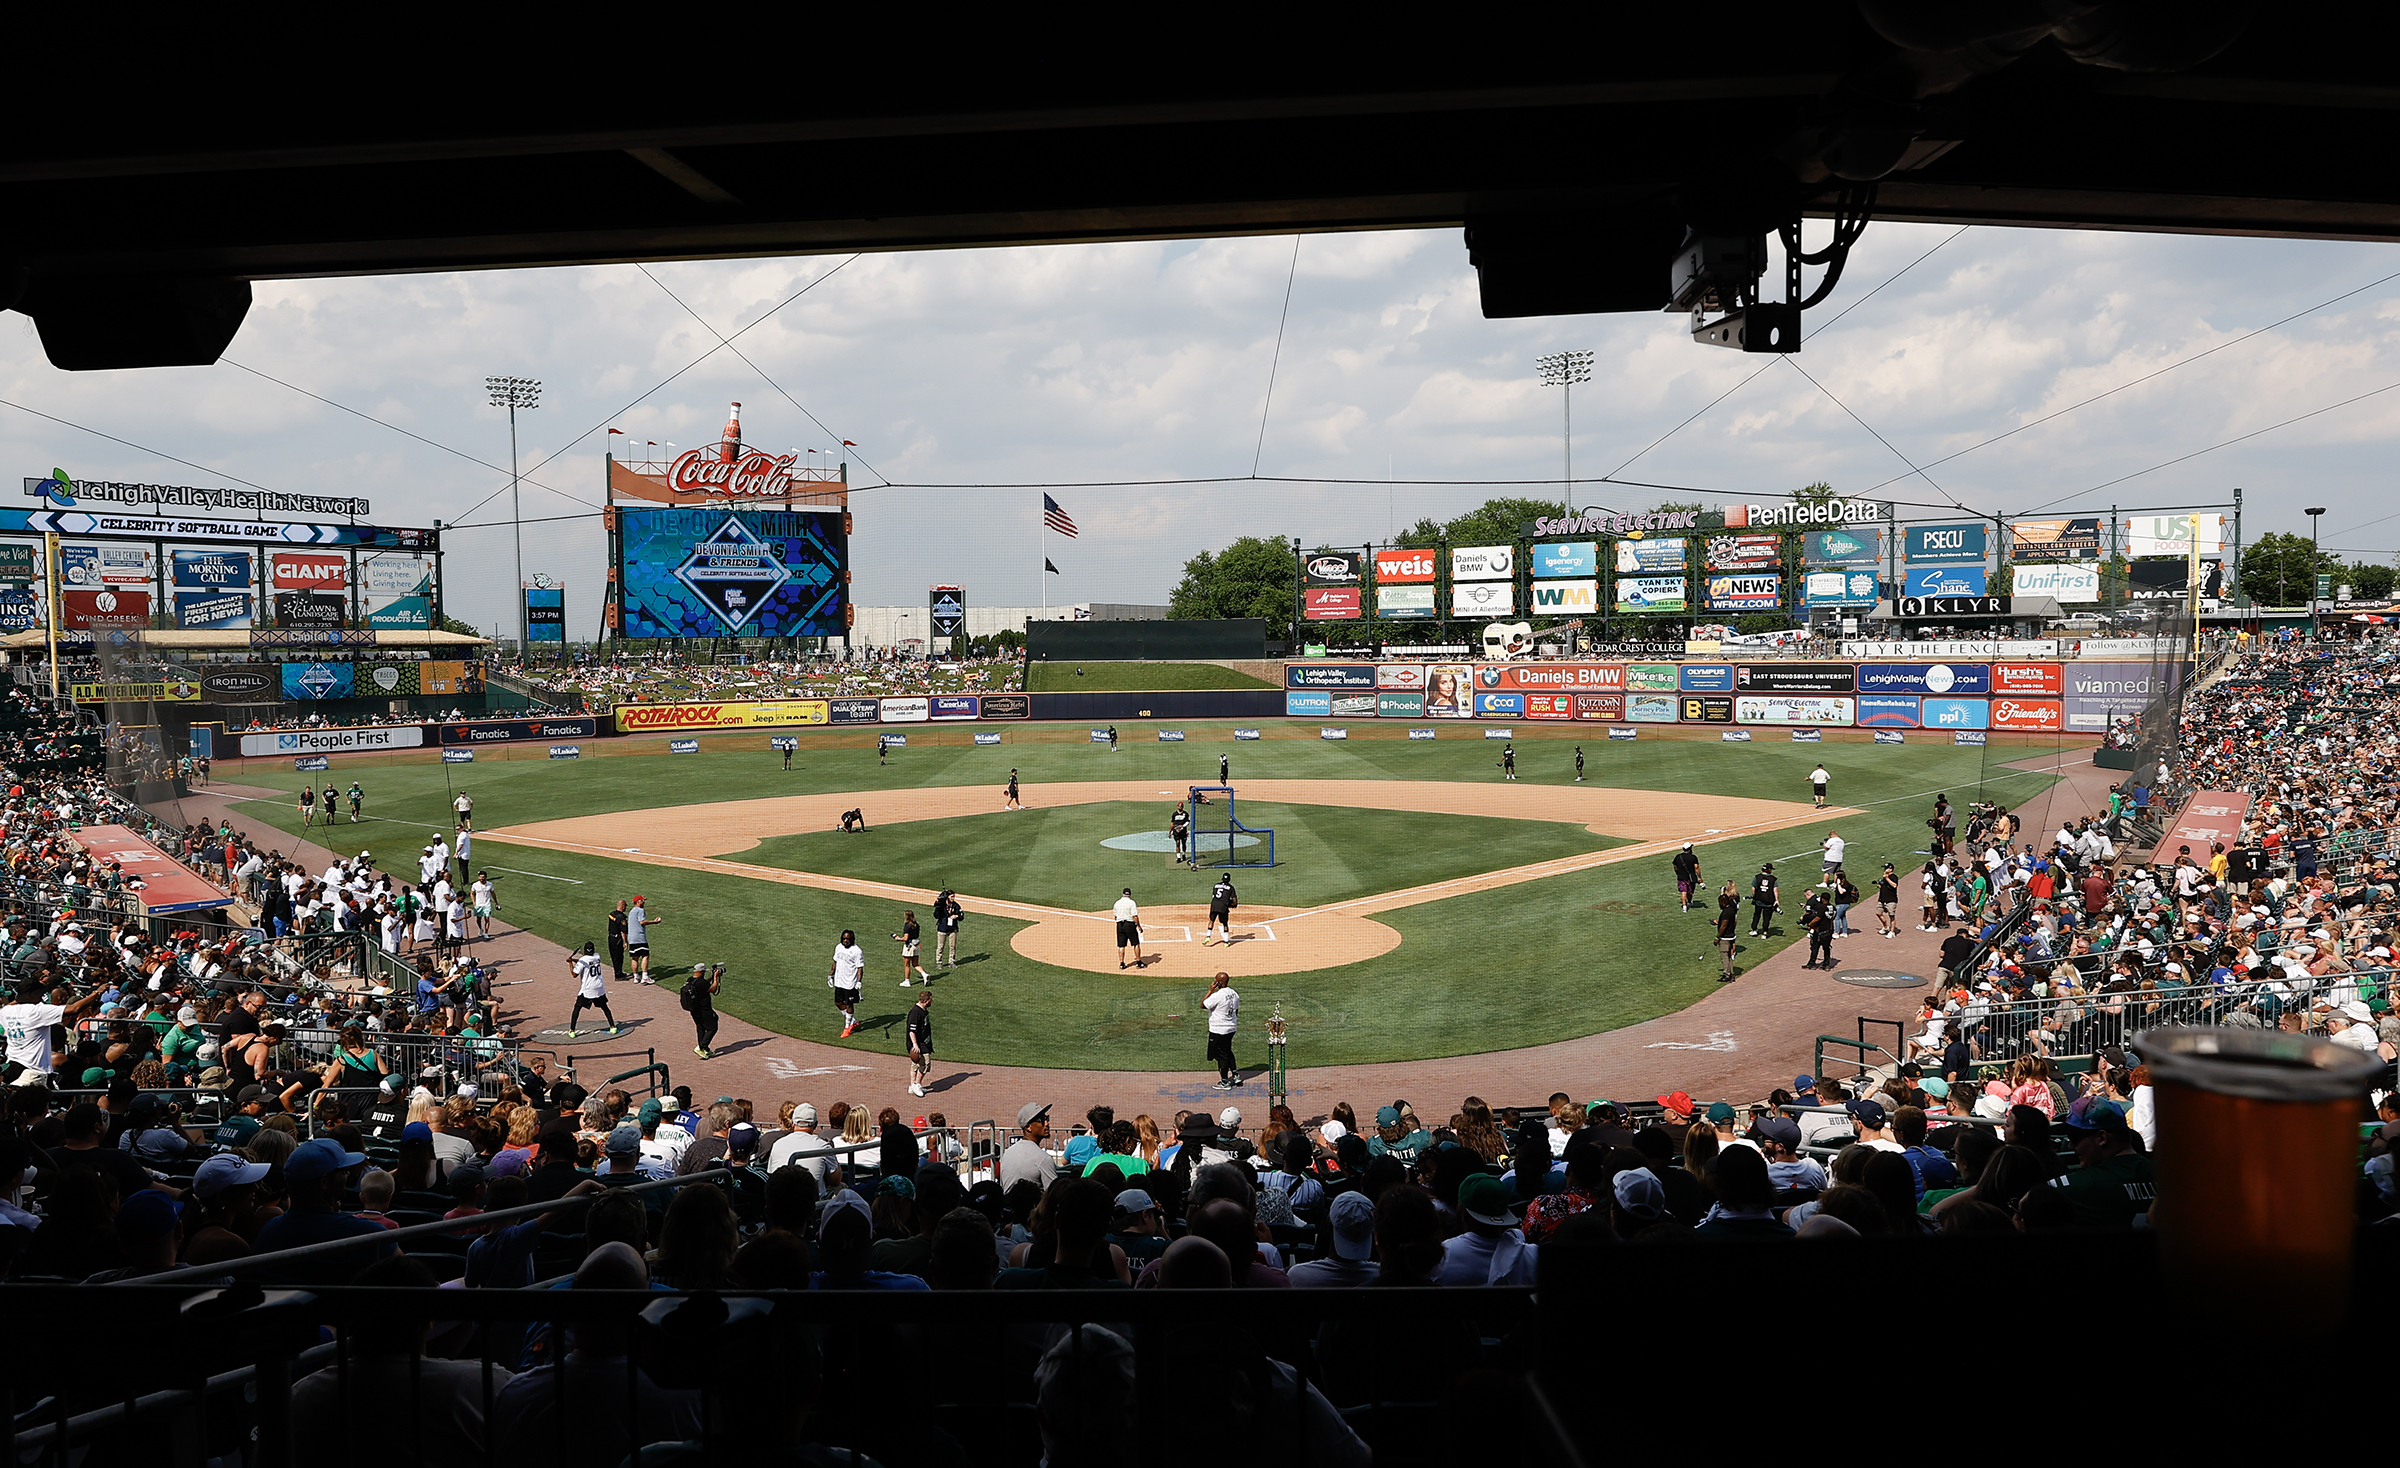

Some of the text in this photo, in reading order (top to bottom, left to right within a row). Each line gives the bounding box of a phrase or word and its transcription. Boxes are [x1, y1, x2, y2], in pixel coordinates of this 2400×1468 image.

[669, 452, 798, 496] Coca-Cola
[78, 480, 367, 515] Lehigh Valley Health Network
[1748, 500, 1878, 525] PenTeleData
[100, 518, 279, 537] CELEBRITY SOFTBALL GAME
[1533, 511, 1698, 537] SERVICE ELECTRIC
[2154, 516, 2190, 541] US
[1924, 531, 1964, 550] PSECU
[2154, 541, 2190, 551] FOODS
[12, 548, 29, 561] Visit
[696, 544, 770, 556] DEVONTA SMITH
[201, 556, 224, 565] THE
[710, 558, 759, 567] & FRIENDS
[1456, 554, 1488, 563] Daniels
[188, 564, 239, 575] MORNING
[372, 561, 419, 570] Working here.
[1378, 555, 1434, 576] weis
[1460, 564, 1484, 573] BMW
[275, 563, 341, 580] GIANT
[373, 570, 412, 579] Living here.
[200, 574, 228, 583] CALL
[1921, 570, 1971, 598] Shane
[2017, 573, 2094, 589] UniFirst
[373, 580, 414, 589] Giving here.
[1710, 577, 1774, 597] 69 NEWS
[197, 600, 216, 609] LEHIGH
[217, 595, 243, 604] VALLEY'S
[1536, 588, 1591, 606] WM
[184, 601, 243, 617] FIRST SOURCE
[1713, 600, 1774, 609] WFMZ.COM
[1933, 599, 2001, 613] KLYR
[76, 615, 138, 624] WIND CREEK
[184, 608, 244, 625] FOR NEWS
[297, 610, 339, 618] LANDSCAPE
[289, 631, 327, 643] Capital
[1590, 642, 1684, 653] CEDAR CREST COLLEGE
[1847, 643, 2004, 655] KLYR THE FENCE
[2086, 641, 2118, 650] Follow
[1306, 669, 1347, 678] Lehigh Valley
[1519, 669, 1621, 684] Daniels BMW
[1997, 666, 2044, 676] Hursh's
[240, 677, 263, 686] HILL
[1306, 676, 1371, 686] Orthopedic Institute
[1630, 671, 1675, 683] Mike Ike
[431, 684, 446, 692] IPA
[2075, 676, 2168, 694] viamedia
[76, 686, 93, 698] A.D.
[882, 703, 927, 712] AmericanBank
[1389, 700, 1421, 711] Phoebe
[1530, 704, 1551, 712] RUSH
[1578, 697, 1620, 708] KUTZTOWN
[1768, 699, 1821, 707] SERVICE ELECTRIC
[1861, 700, 1917, 708] HomeRunRehab.org
[2100, 703, 2142, 711] On Screen
[833, 704, 876, 713] DUAL TEMP
[1138, 709, 1151, 717] 400
[1632, 705, 1655, 714] Dorney
[1996, 701, 2059, 722] Friendly's
[752, 714, 774, 724] Jeep
[849, 710, 873, 719] team
[1939, 711, 1960, 725] ppl
[471, 728, 510, 741] Fanatics
[543, 725, 582, 737] Fanatics
[300, 731, 390, 750] People First
[2250, 857, 2257, 870] 1
[1215, 889, 1223, 899] 5
[589, 964, 602, 978] 00
[371, 1111, 396, 1123] HURTS
[674, 1115, 690, 1124] LEY
[1386, 1148, 1416, 1160] SMITH
